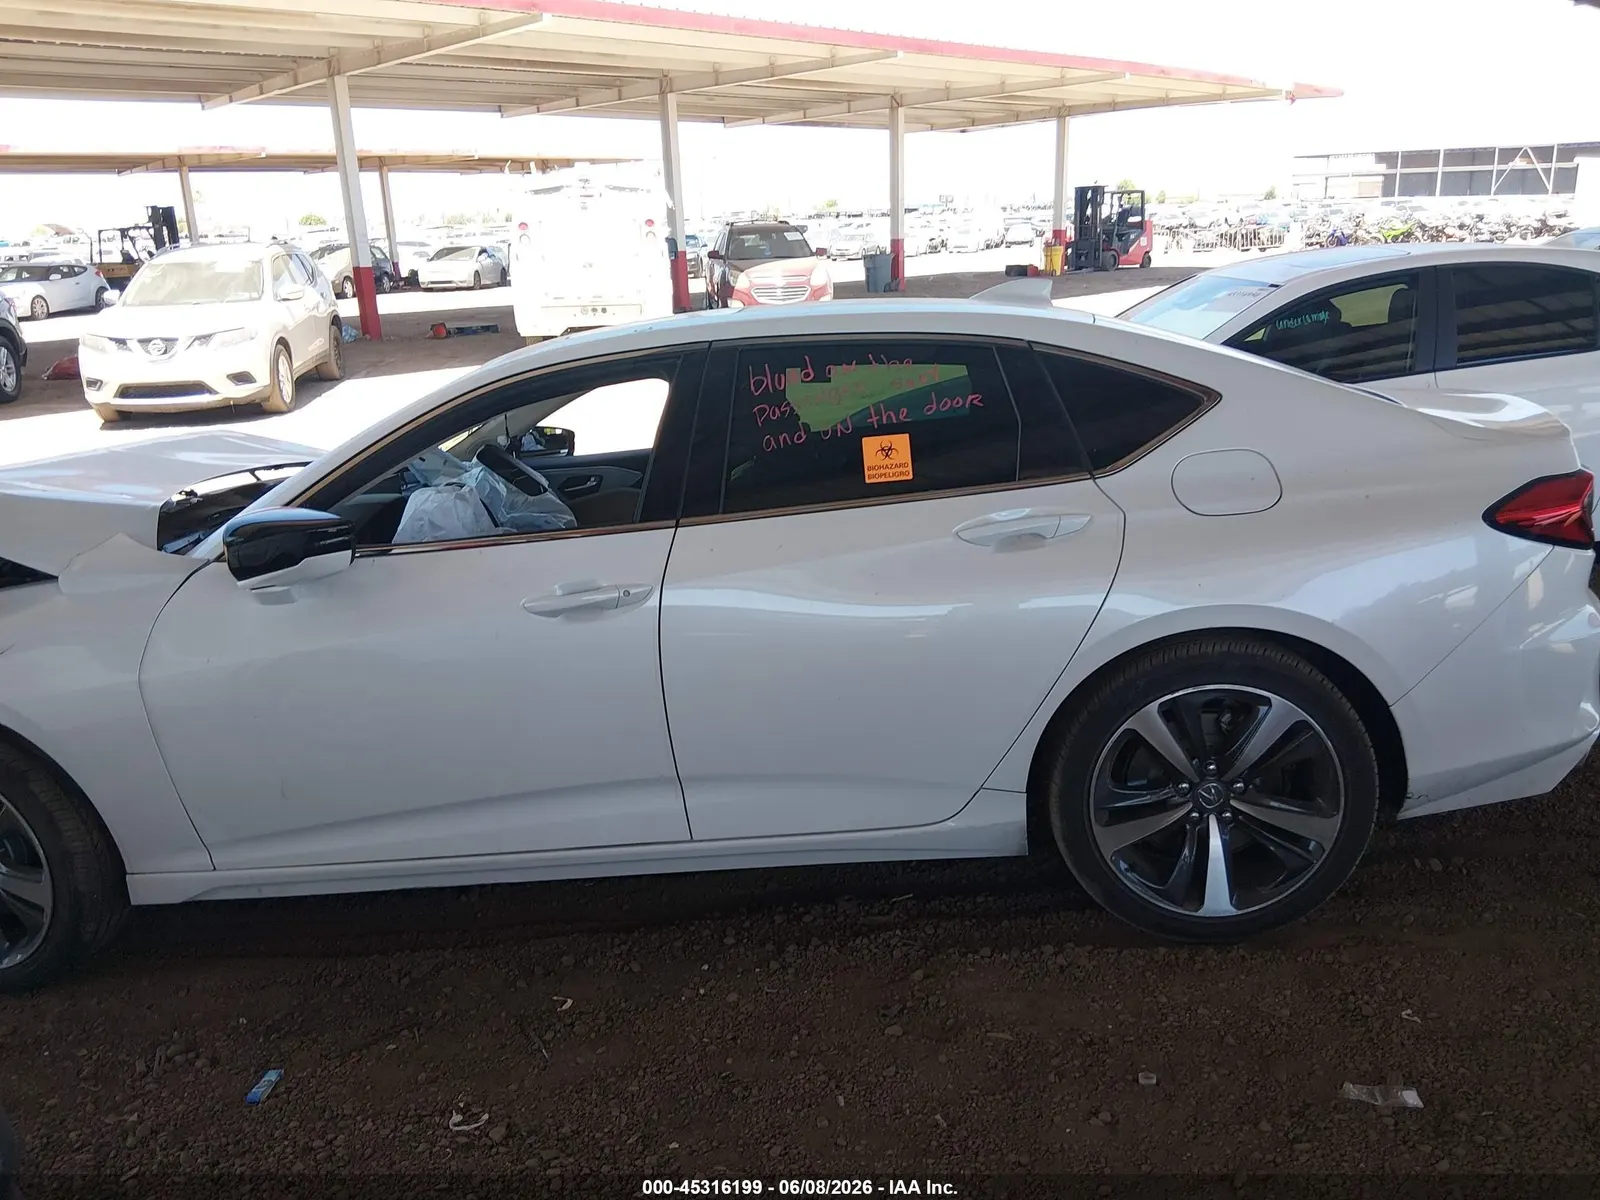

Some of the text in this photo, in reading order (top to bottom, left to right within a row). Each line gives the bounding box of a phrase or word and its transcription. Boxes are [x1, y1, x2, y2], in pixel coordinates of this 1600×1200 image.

[762, 421, 807, 451] and
[866, 403, 910, 429] the
[867, 462, 909, 472] BIOHAZARD
[867, 470, 910, 480] BIOPELIGRO
